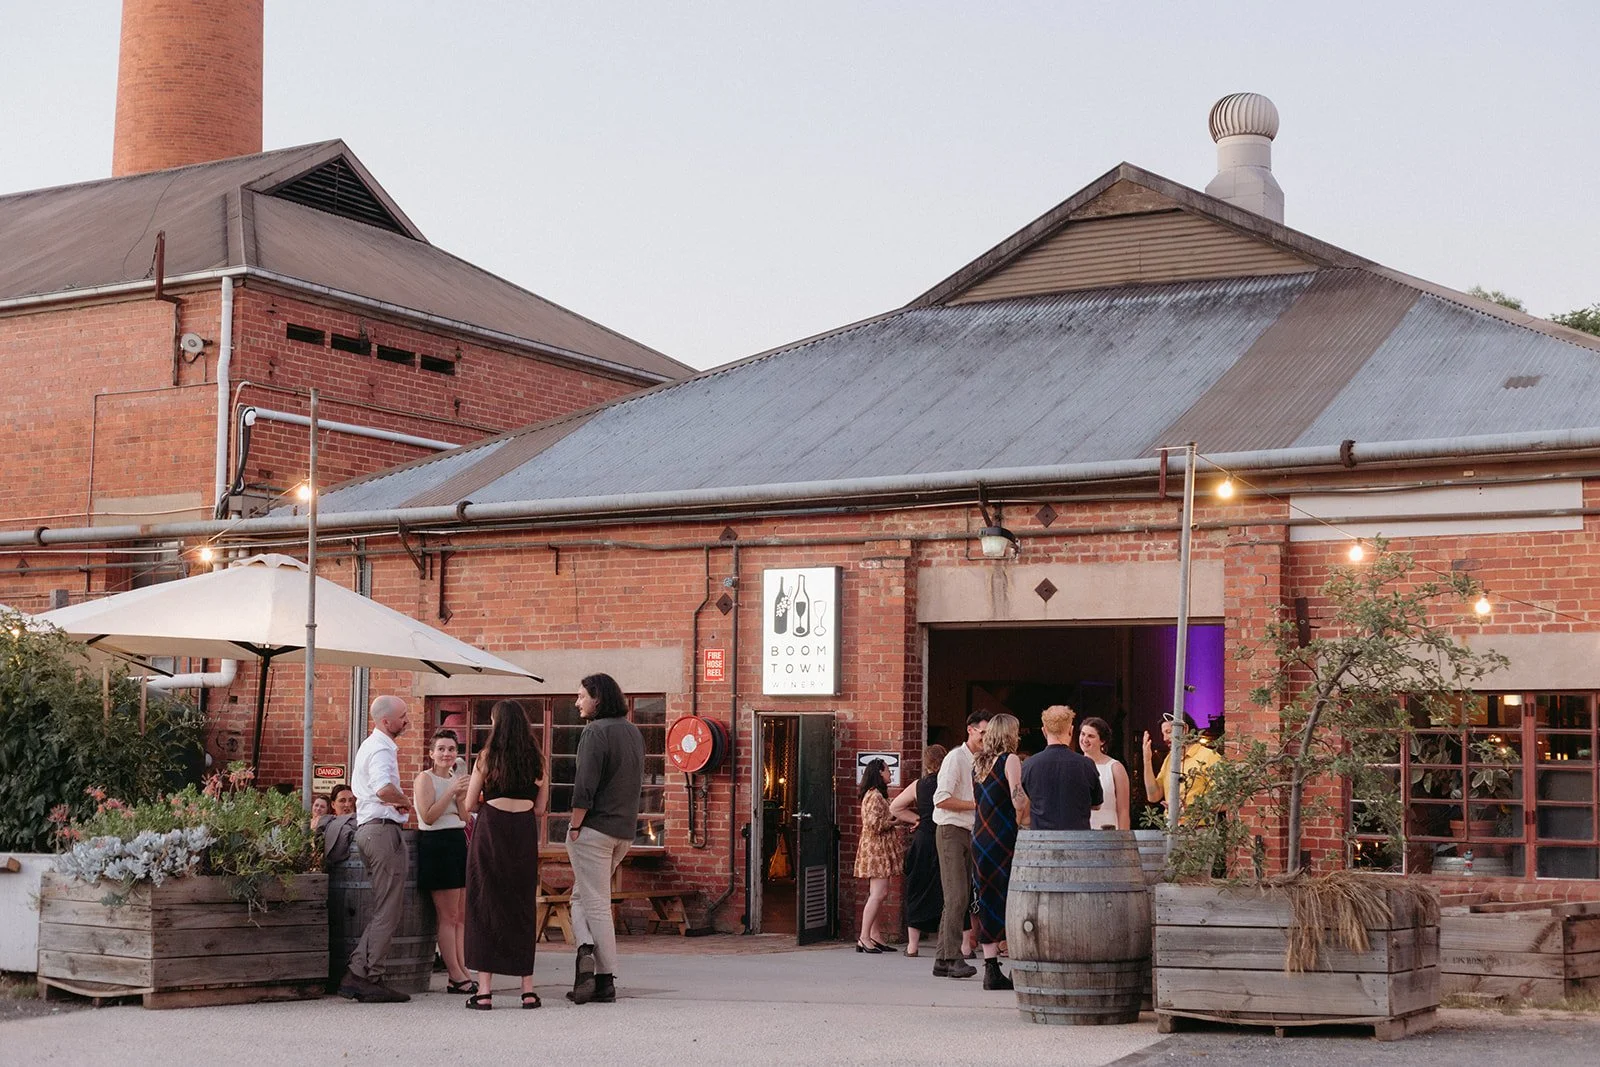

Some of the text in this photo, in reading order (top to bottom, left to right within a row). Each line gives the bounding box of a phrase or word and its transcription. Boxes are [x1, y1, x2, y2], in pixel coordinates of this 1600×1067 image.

[770, 645, 827, 656] BOOM
[707, 651, 722, 660] FIRE
[706, 660, 723, 668] HOSE
[770, 663, 826, 674] TOWN
[706, 668, 723, 677] REEL
[771, 680, 826, 689] WINERY
[317, 768, 342, 776] DANGER
